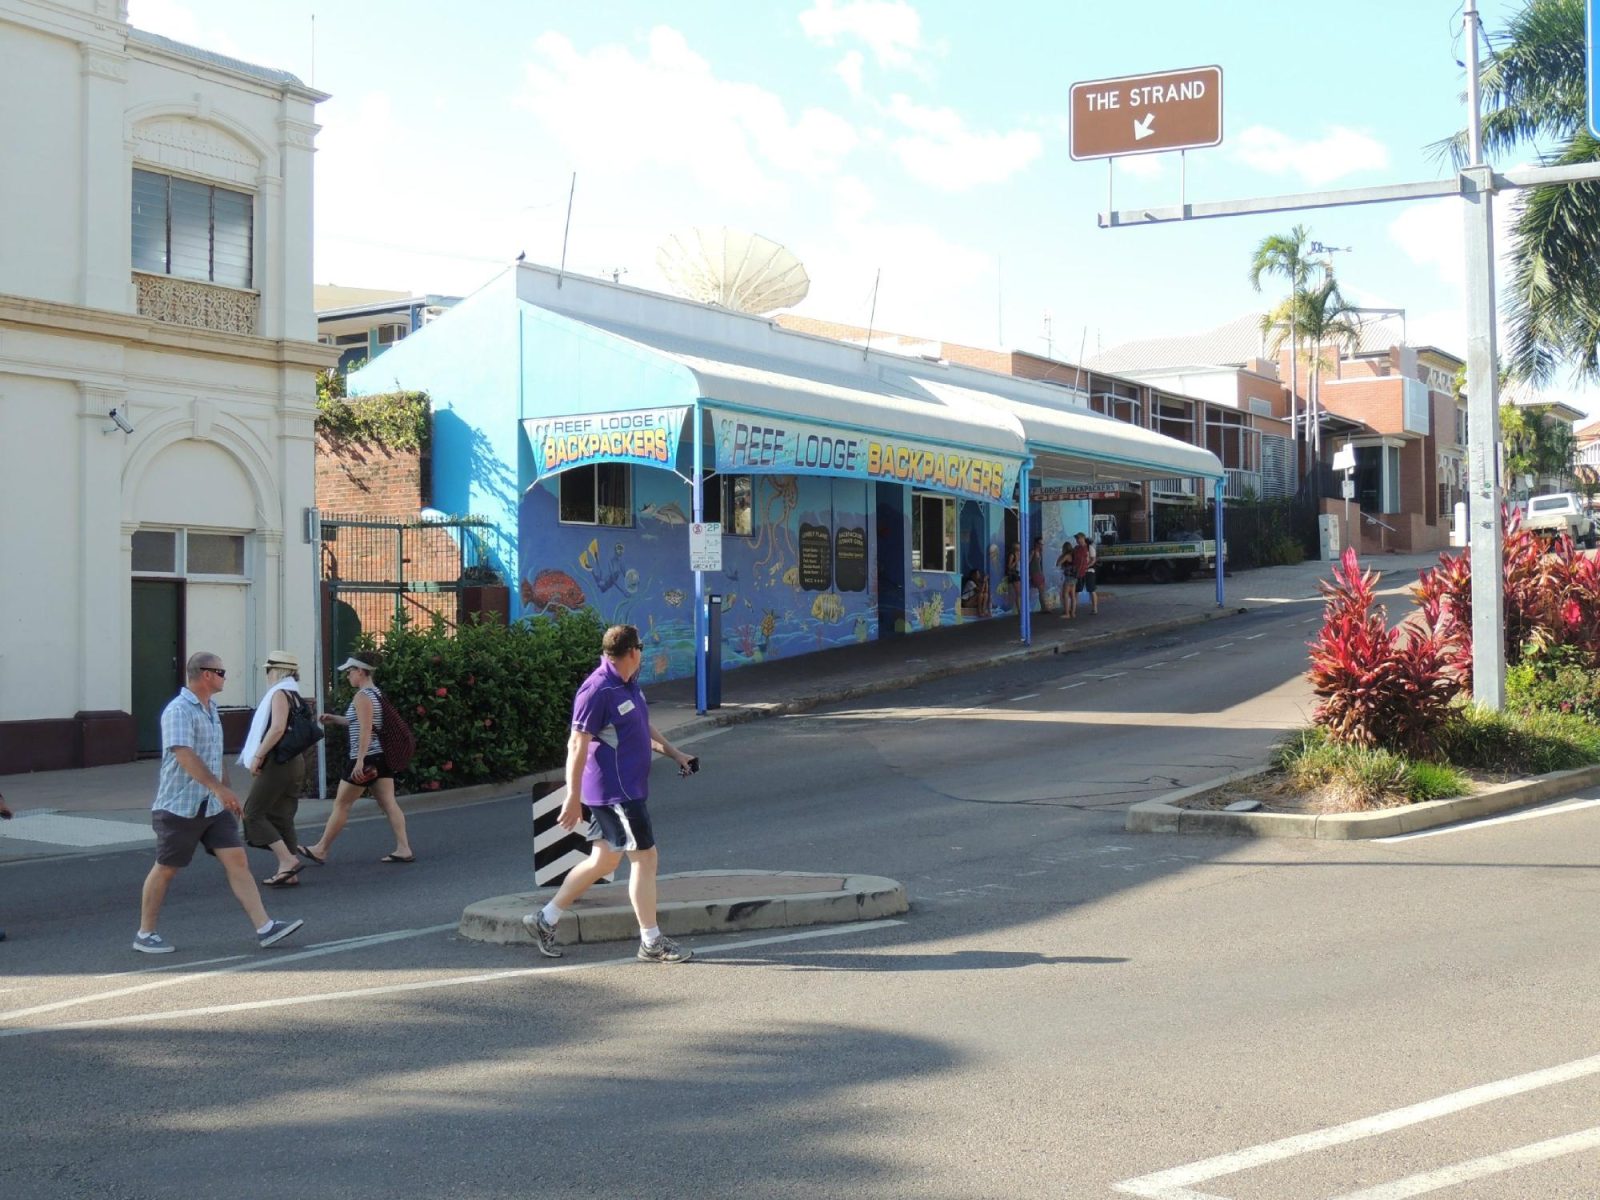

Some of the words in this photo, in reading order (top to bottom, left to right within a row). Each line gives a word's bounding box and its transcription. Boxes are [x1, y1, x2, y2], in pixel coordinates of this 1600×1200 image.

[1086, 90, 1120, 111] THE
[1129, 80, 1205, 107] STRAND
[554, 419, 592, 433] REEF
[600, 414, 654, 430] LODGE
[544, 428, 669, 470] BACKPACKERS
[732, 423, 786, 466] REEF
[794, 434, 857, 471] LODGE
[866, 440, 1005, 499] BACKPACKERS
[1032, 492, 1099, 501] OFFICE
[1040, 486, 1063, 494] LODGE
[1066, 484, 1116, 493] BACKPACKERS
[707, 523, 720, 532] 2P
